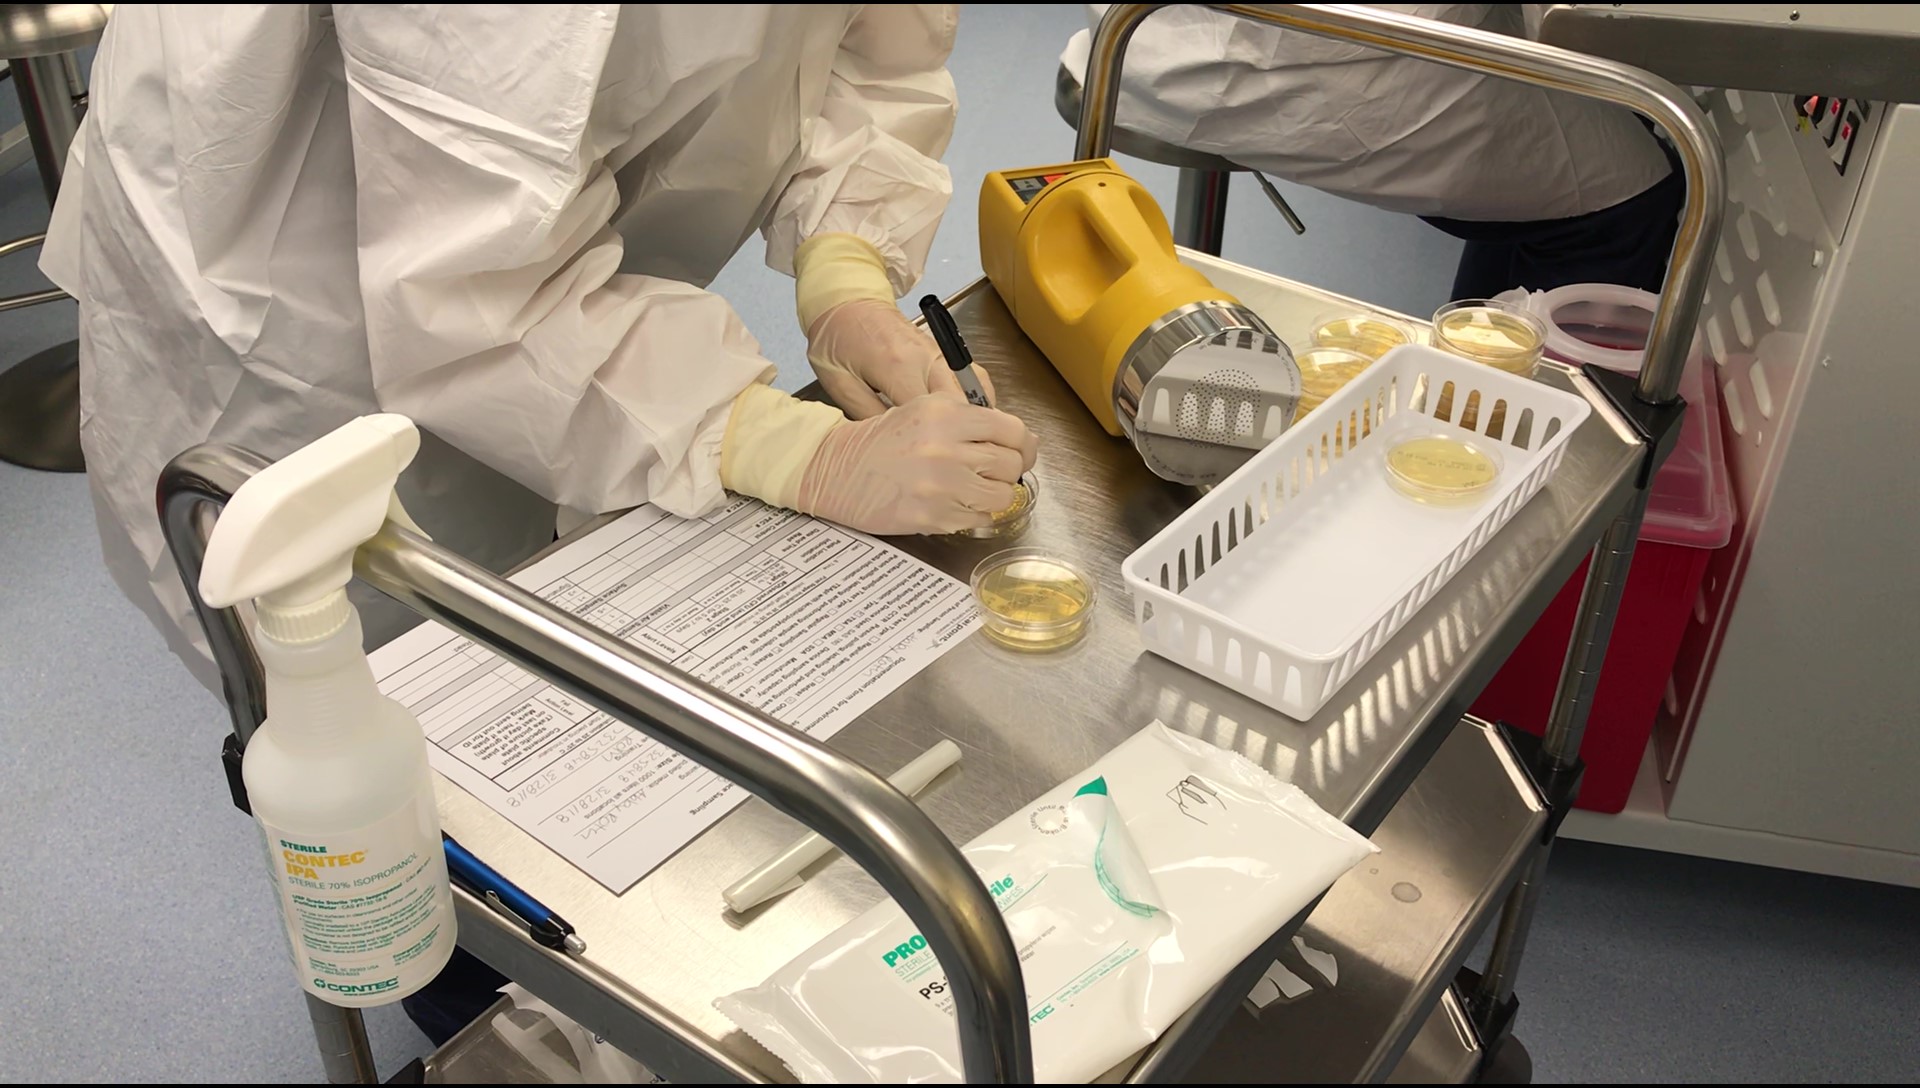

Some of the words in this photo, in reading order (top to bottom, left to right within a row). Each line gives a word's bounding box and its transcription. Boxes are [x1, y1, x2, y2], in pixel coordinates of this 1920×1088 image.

[861, 572, 888, 590] Sampling
[602, 582, 627, 598] Surface
[850, 590, 864, 599] Test
[886, 587, 913, 605] Sampling
[575, 597, 603, 614] Samples
[903, 599, 930, 617] Sampling
[806, 613, 829, 629] Regular
[892, 616, 906, 626] Test
[778, 628, 808, 647] Sampling
[808, 646, 829, 660] Device
[848, 641, 871, 657] Regular
[781, 660, 809, 679] sampling
[820, 657, 849, 676] Sampling
[861, 656, 905, 688] Documentation
[771, 675, 804, 699] performing
[845, 687, 863, 700] Form
[509, 702, 531, 716] being
[518, 708, 535, 720] Mark
[494, 715, 510, 727] sent
[496, 723, 513, 734] here
[521, 716, 536, 727] last
[471, 736, 490, 749] plate
[508, 726, 532, 743] picture
[519, 727, 546, 745] specific
[522, 727, 560, 751] Comments
[481, 747, 499, 760] plate
[501, 743, 519, 756] plate
[501, 750, 522, 765] about
[689, 792, 723, 815] Sampling
[280, 840, 327, 853] STERILE
[283, 850, 366, 868] CONTEC
[285, 863, 320, 880] IPA
[288, 877, 325, 889] STERILE
[328, 880, 350, 889] 70%
[353, 852, 418, 886] ISOPROPANOL
[895, 951, 934, 976] STERILE
[327, 978, 398, 992] CONTEC
[919, 974, 948, 999] PS-
